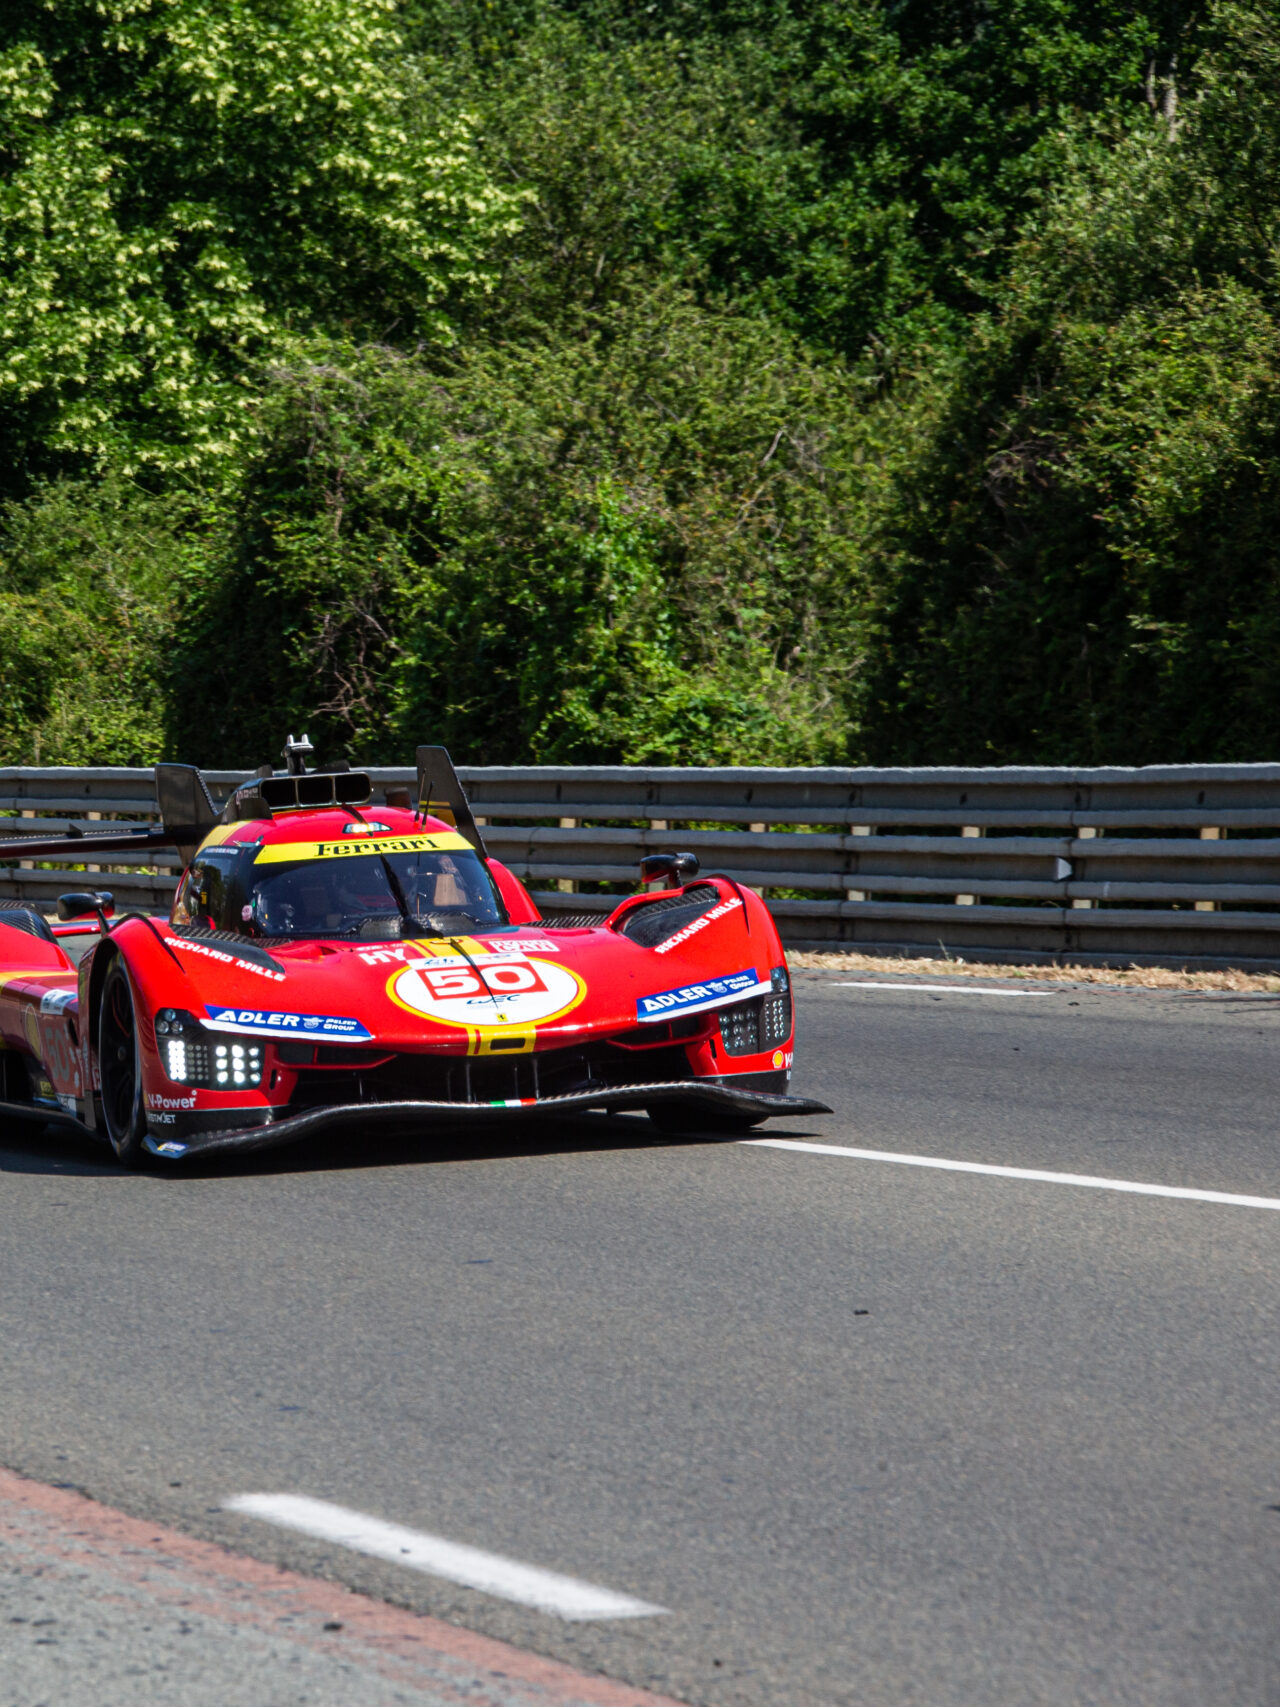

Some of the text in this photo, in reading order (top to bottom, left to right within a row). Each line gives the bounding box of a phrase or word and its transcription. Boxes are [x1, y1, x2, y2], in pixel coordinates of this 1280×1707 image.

[314, 837, 441, 857] Ferrari
[654, 897, 743, 954] RICHARD MILLE
[164, 936, 287, 982] RICHARD MILLE
[358, 948, 407, 966] HY
[424, 965, 537, 997] 50
[642, 986, 713, 1012] ADLER
[214, 1010, 301, 1027] ADLER
[323, 1024, 356, 1032] GROUP
